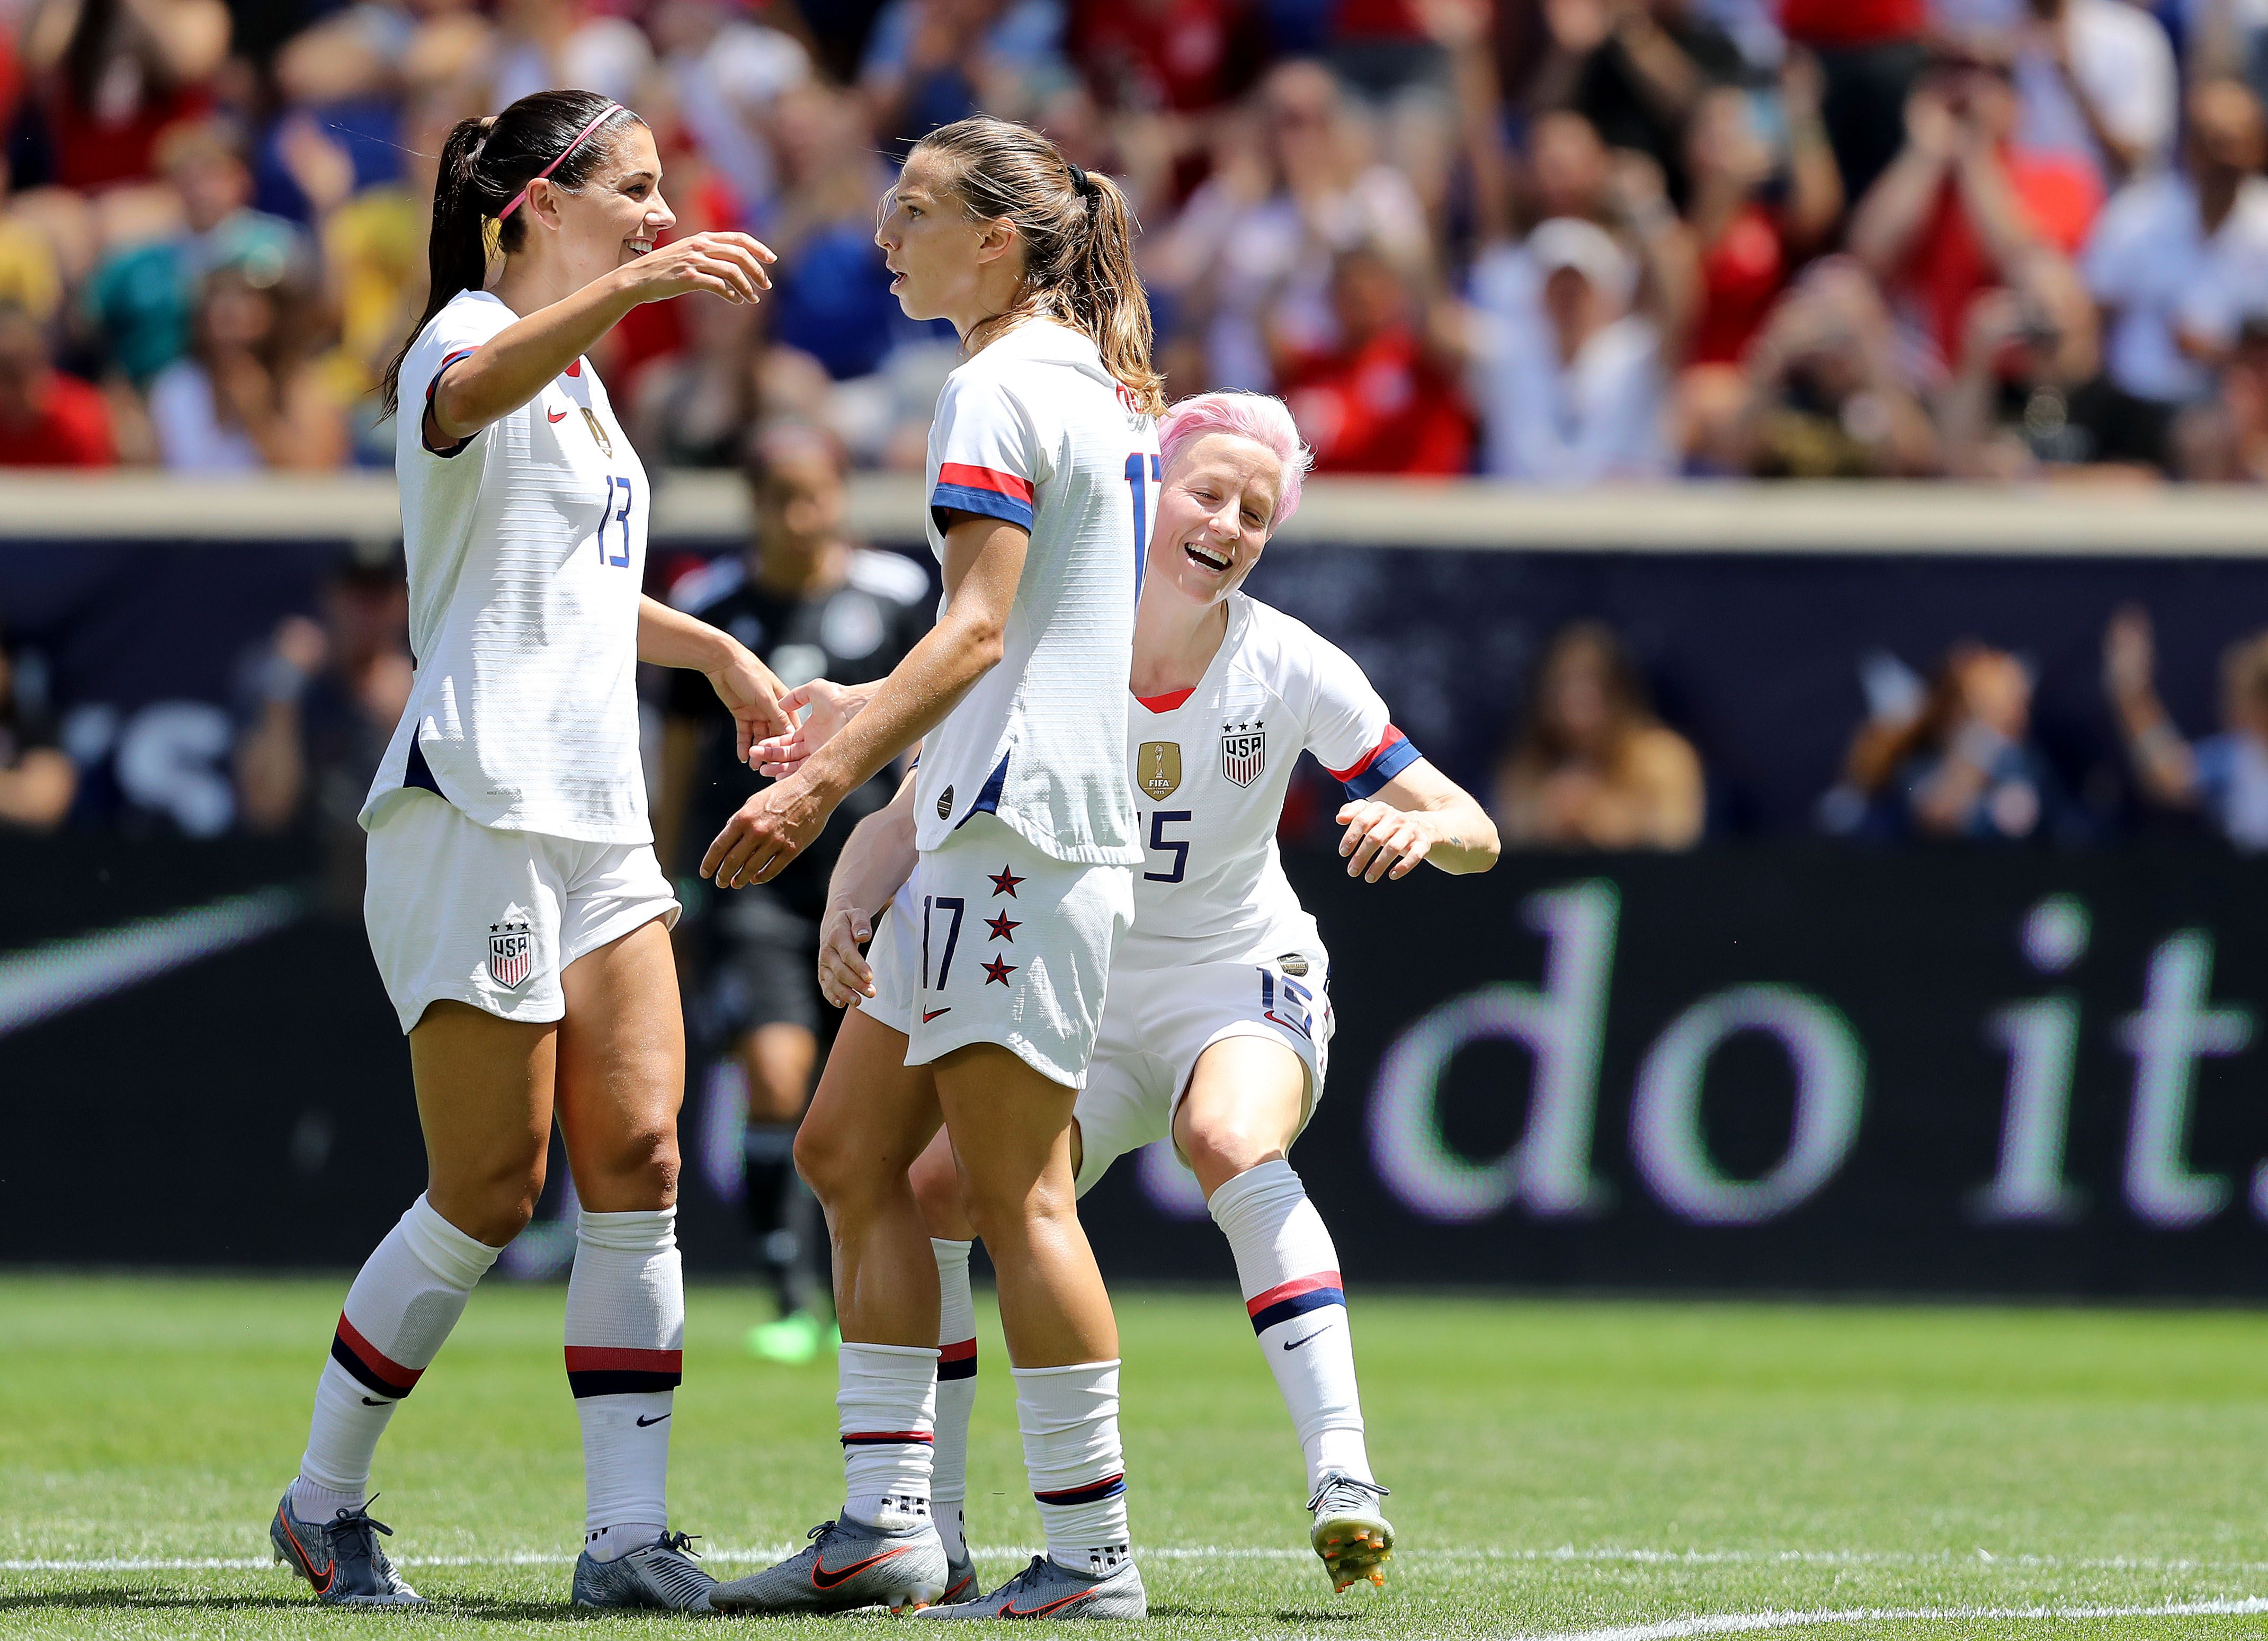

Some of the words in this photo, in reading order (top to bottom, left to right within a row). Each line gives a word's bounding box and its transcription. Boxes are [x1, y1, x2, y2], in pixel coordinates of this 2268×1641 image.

[598, 475, 631, 568] 13
[1226, 737, 1261, 758] USA
[1137, 810, 1192, 884] 5
[494, 937, 527, 957] USA
[923, 895, 965, 991] 17
[1255, 966, 1312, 1040] 15
[1367, 877, 1867, 1225] do
[1970, 894, 2268, 1226] it
